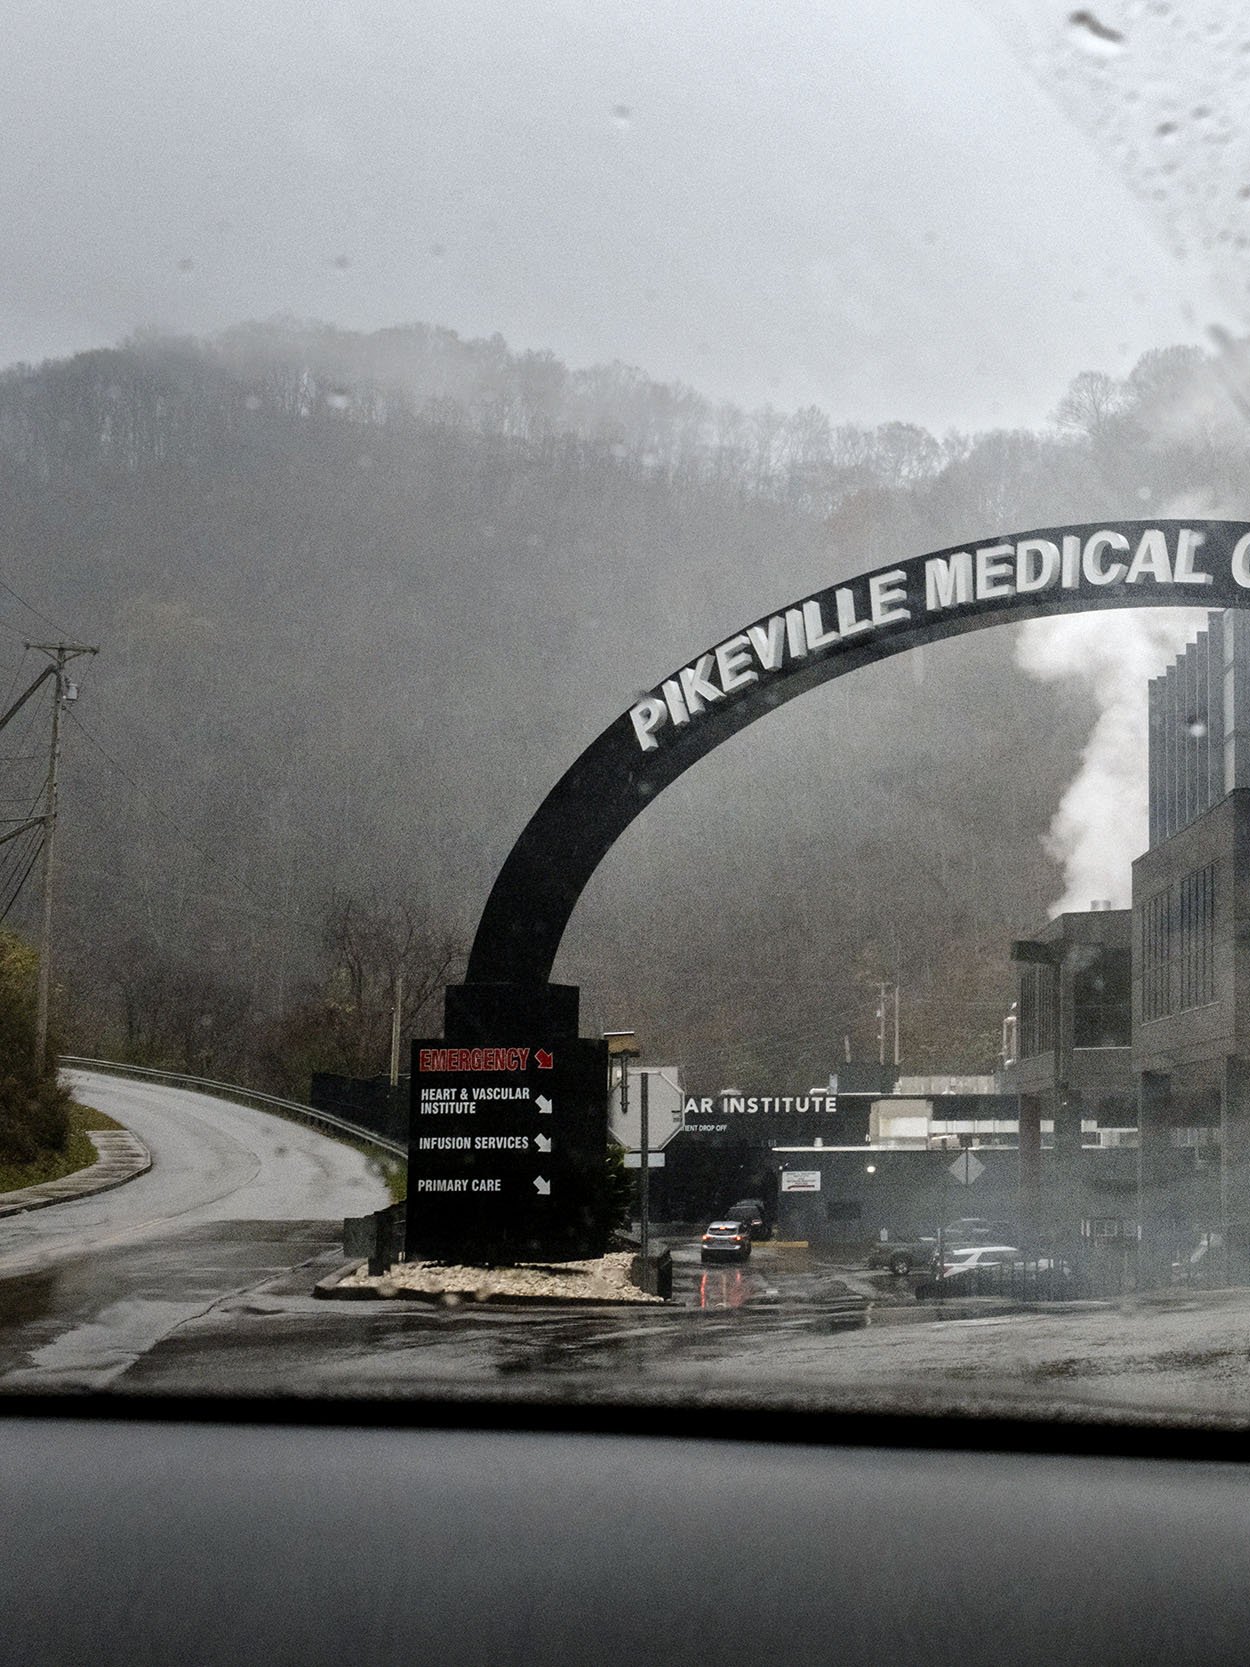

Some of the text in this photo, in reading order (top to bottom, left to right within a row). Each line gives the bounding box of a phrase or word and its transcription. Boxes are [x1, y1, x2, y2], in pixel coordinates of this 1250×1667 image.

[629, 570, 911, 752] PIKEVILLE
[925, 529, 1213, 612] MEDICAL
[419, 1048, 529, 1071] EMERGENCY
[421, 1087, 530, 1100] HEART & VASCULAR
[420, 1102, 476, 1115] INSTITUTE
[684, 1096, 837, 1114] AR INSTITUTE
[419, 1136, 529, 1150] INFUSION SERVICES
[418, 1180, 502, 1192] PRIMARY CARE
